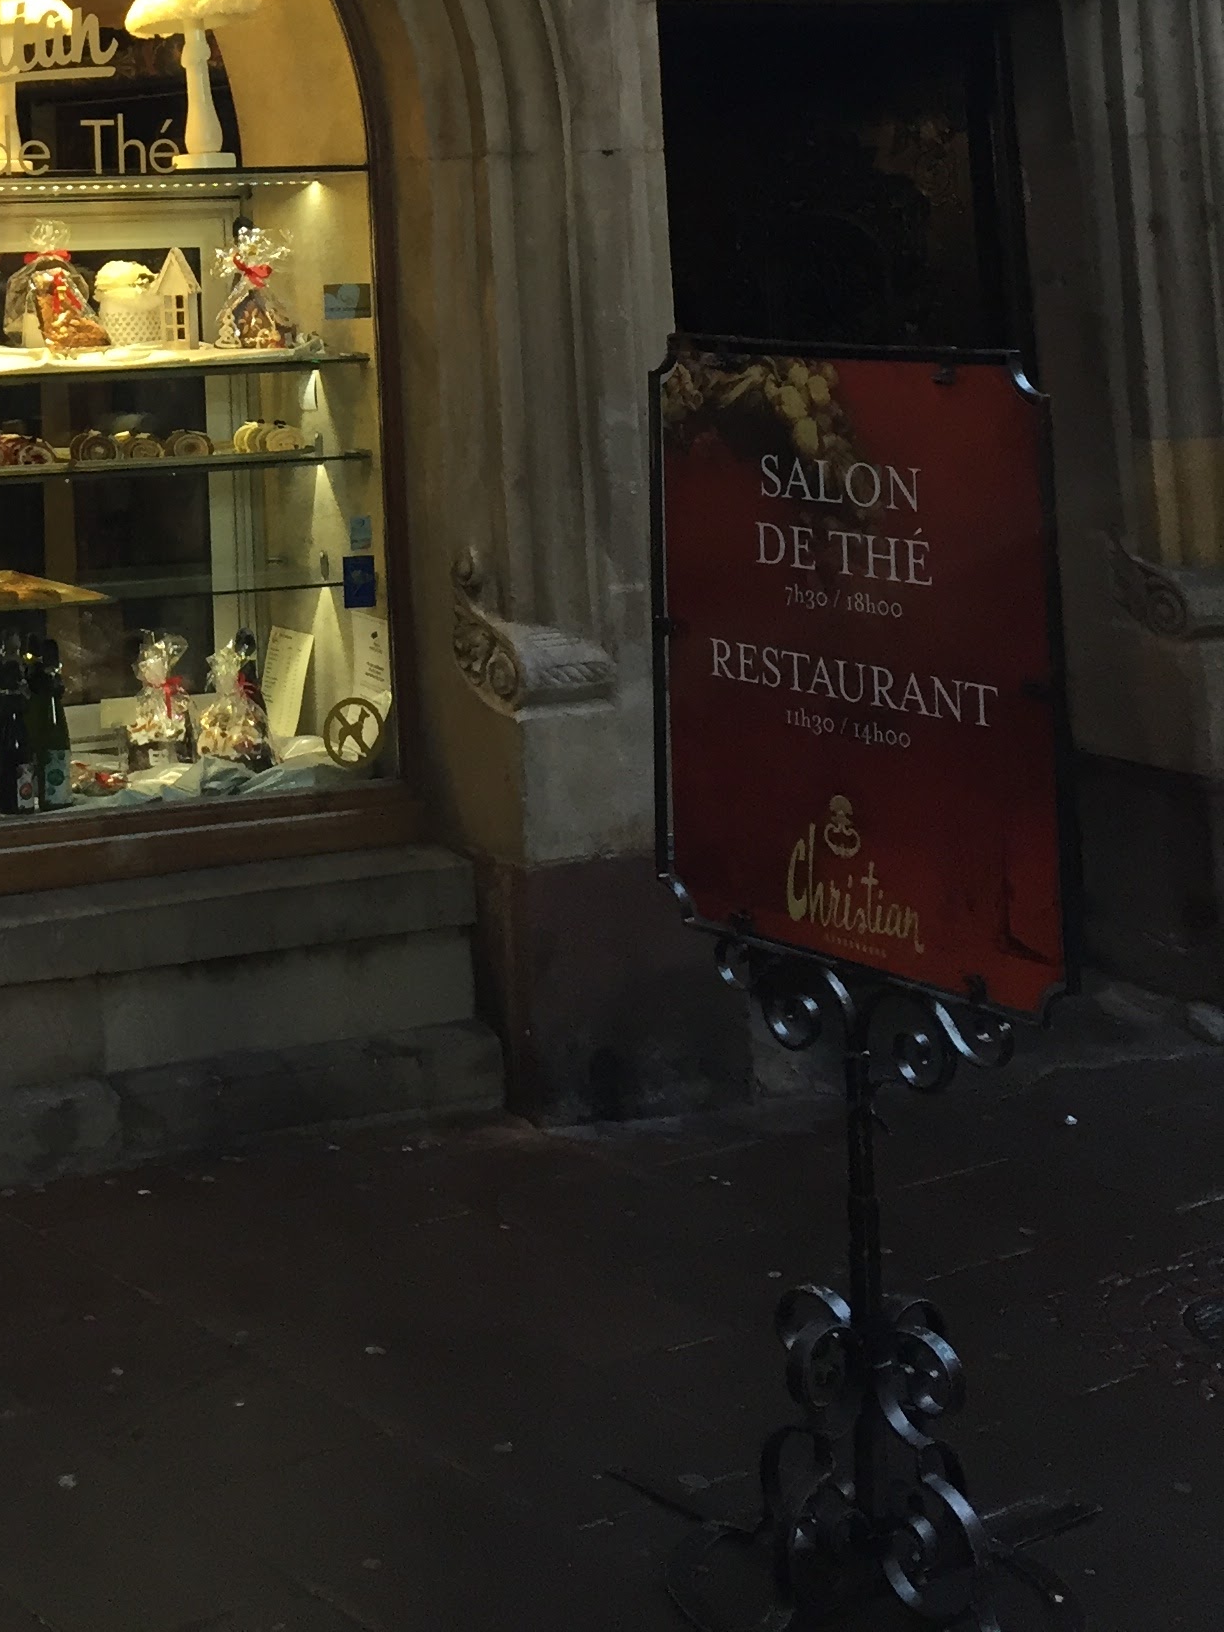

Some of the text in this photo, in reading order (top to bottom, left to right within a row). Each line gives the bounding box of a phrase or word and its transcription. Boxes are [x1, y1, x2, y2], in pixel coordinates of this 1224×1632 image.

[79, 114, 180, 175] Thé
[760, 453, 922, 512] SALON
[755, 521, 933, 586] DE THÉ
[785, 584, 828, 610] 7h30
[846, 592, 904, 619] 18h00
[709, 637, 999, 728] RESTAURANT
[785, 707, 835, 736] 11h30
[853, 722, 912, 749] 14h00
[786, 822, 926, 954] Christian
